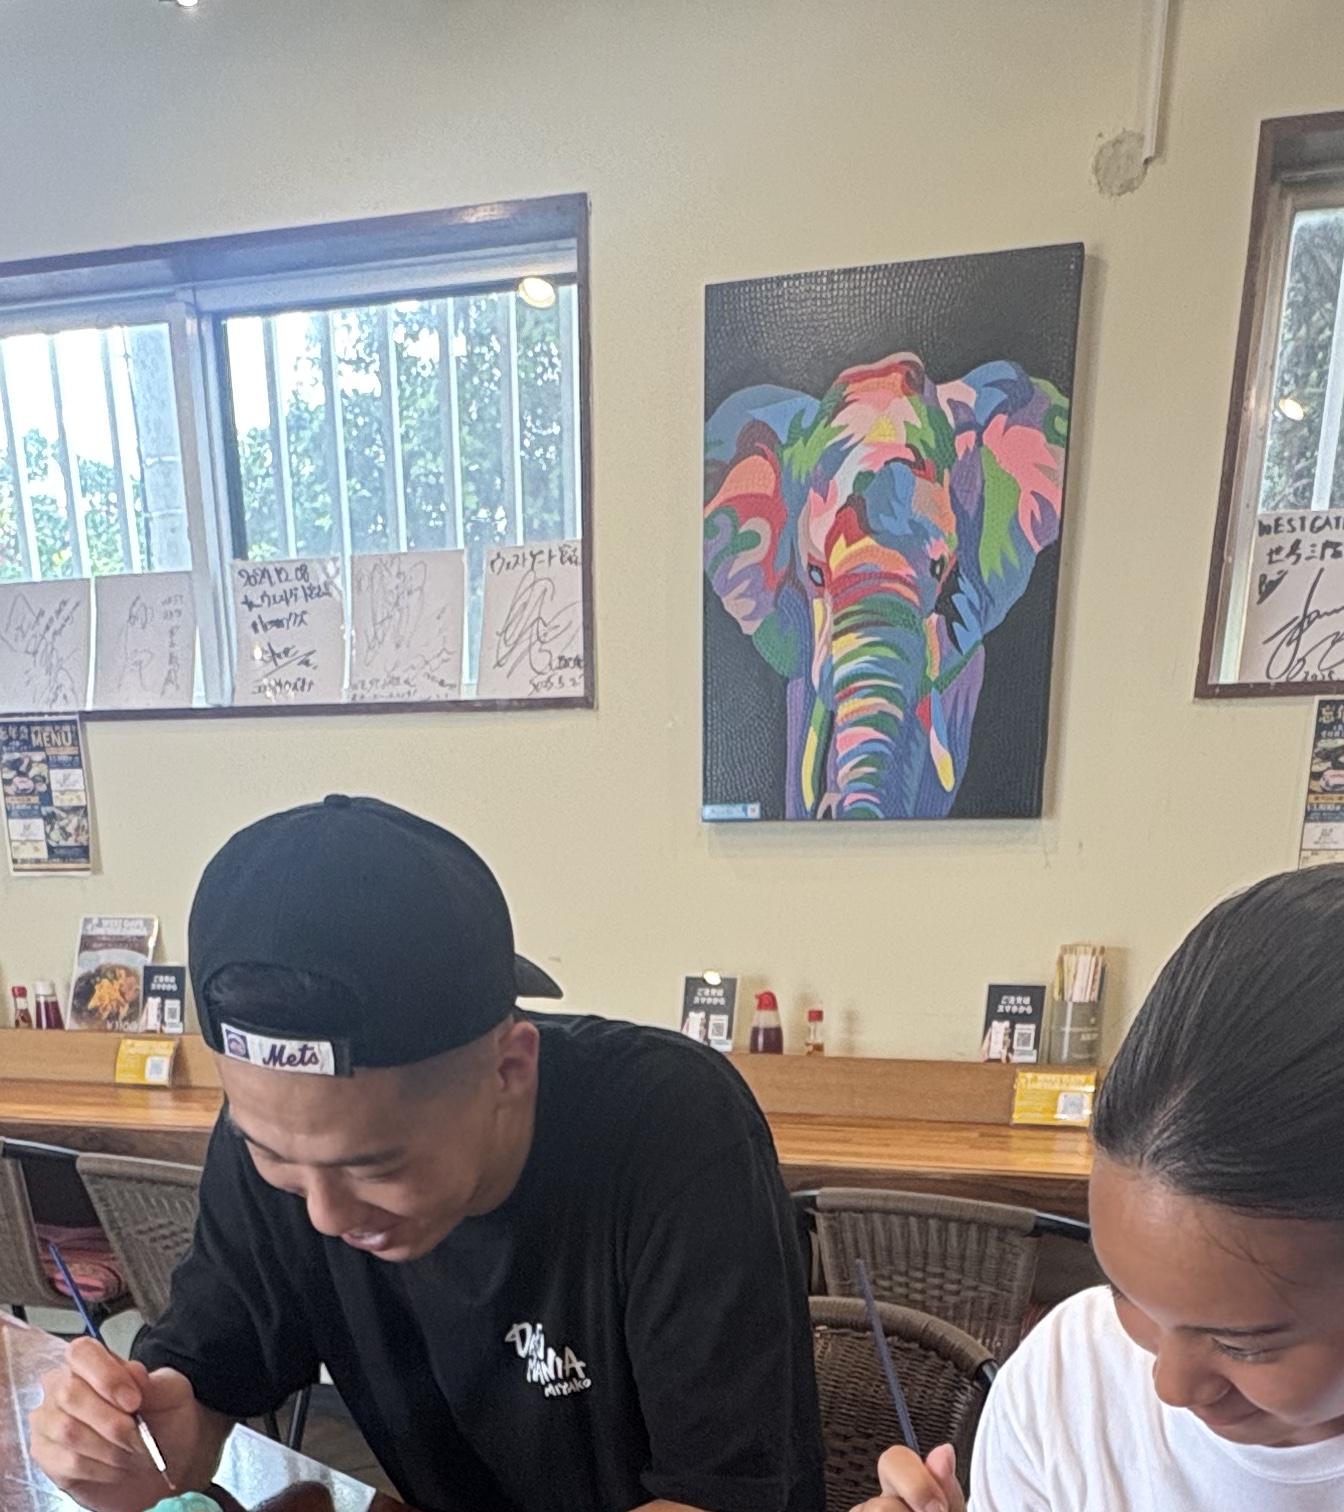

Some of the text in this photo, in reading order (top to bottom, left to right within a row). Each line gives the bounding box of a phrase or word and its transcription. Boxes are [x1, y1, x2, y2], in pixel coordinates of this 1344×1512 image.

[30, 727, 73, 748] MENU
[262, 1044, 320, 1068] Mets
[543, 1377, 592, 1398] MIYAKO
